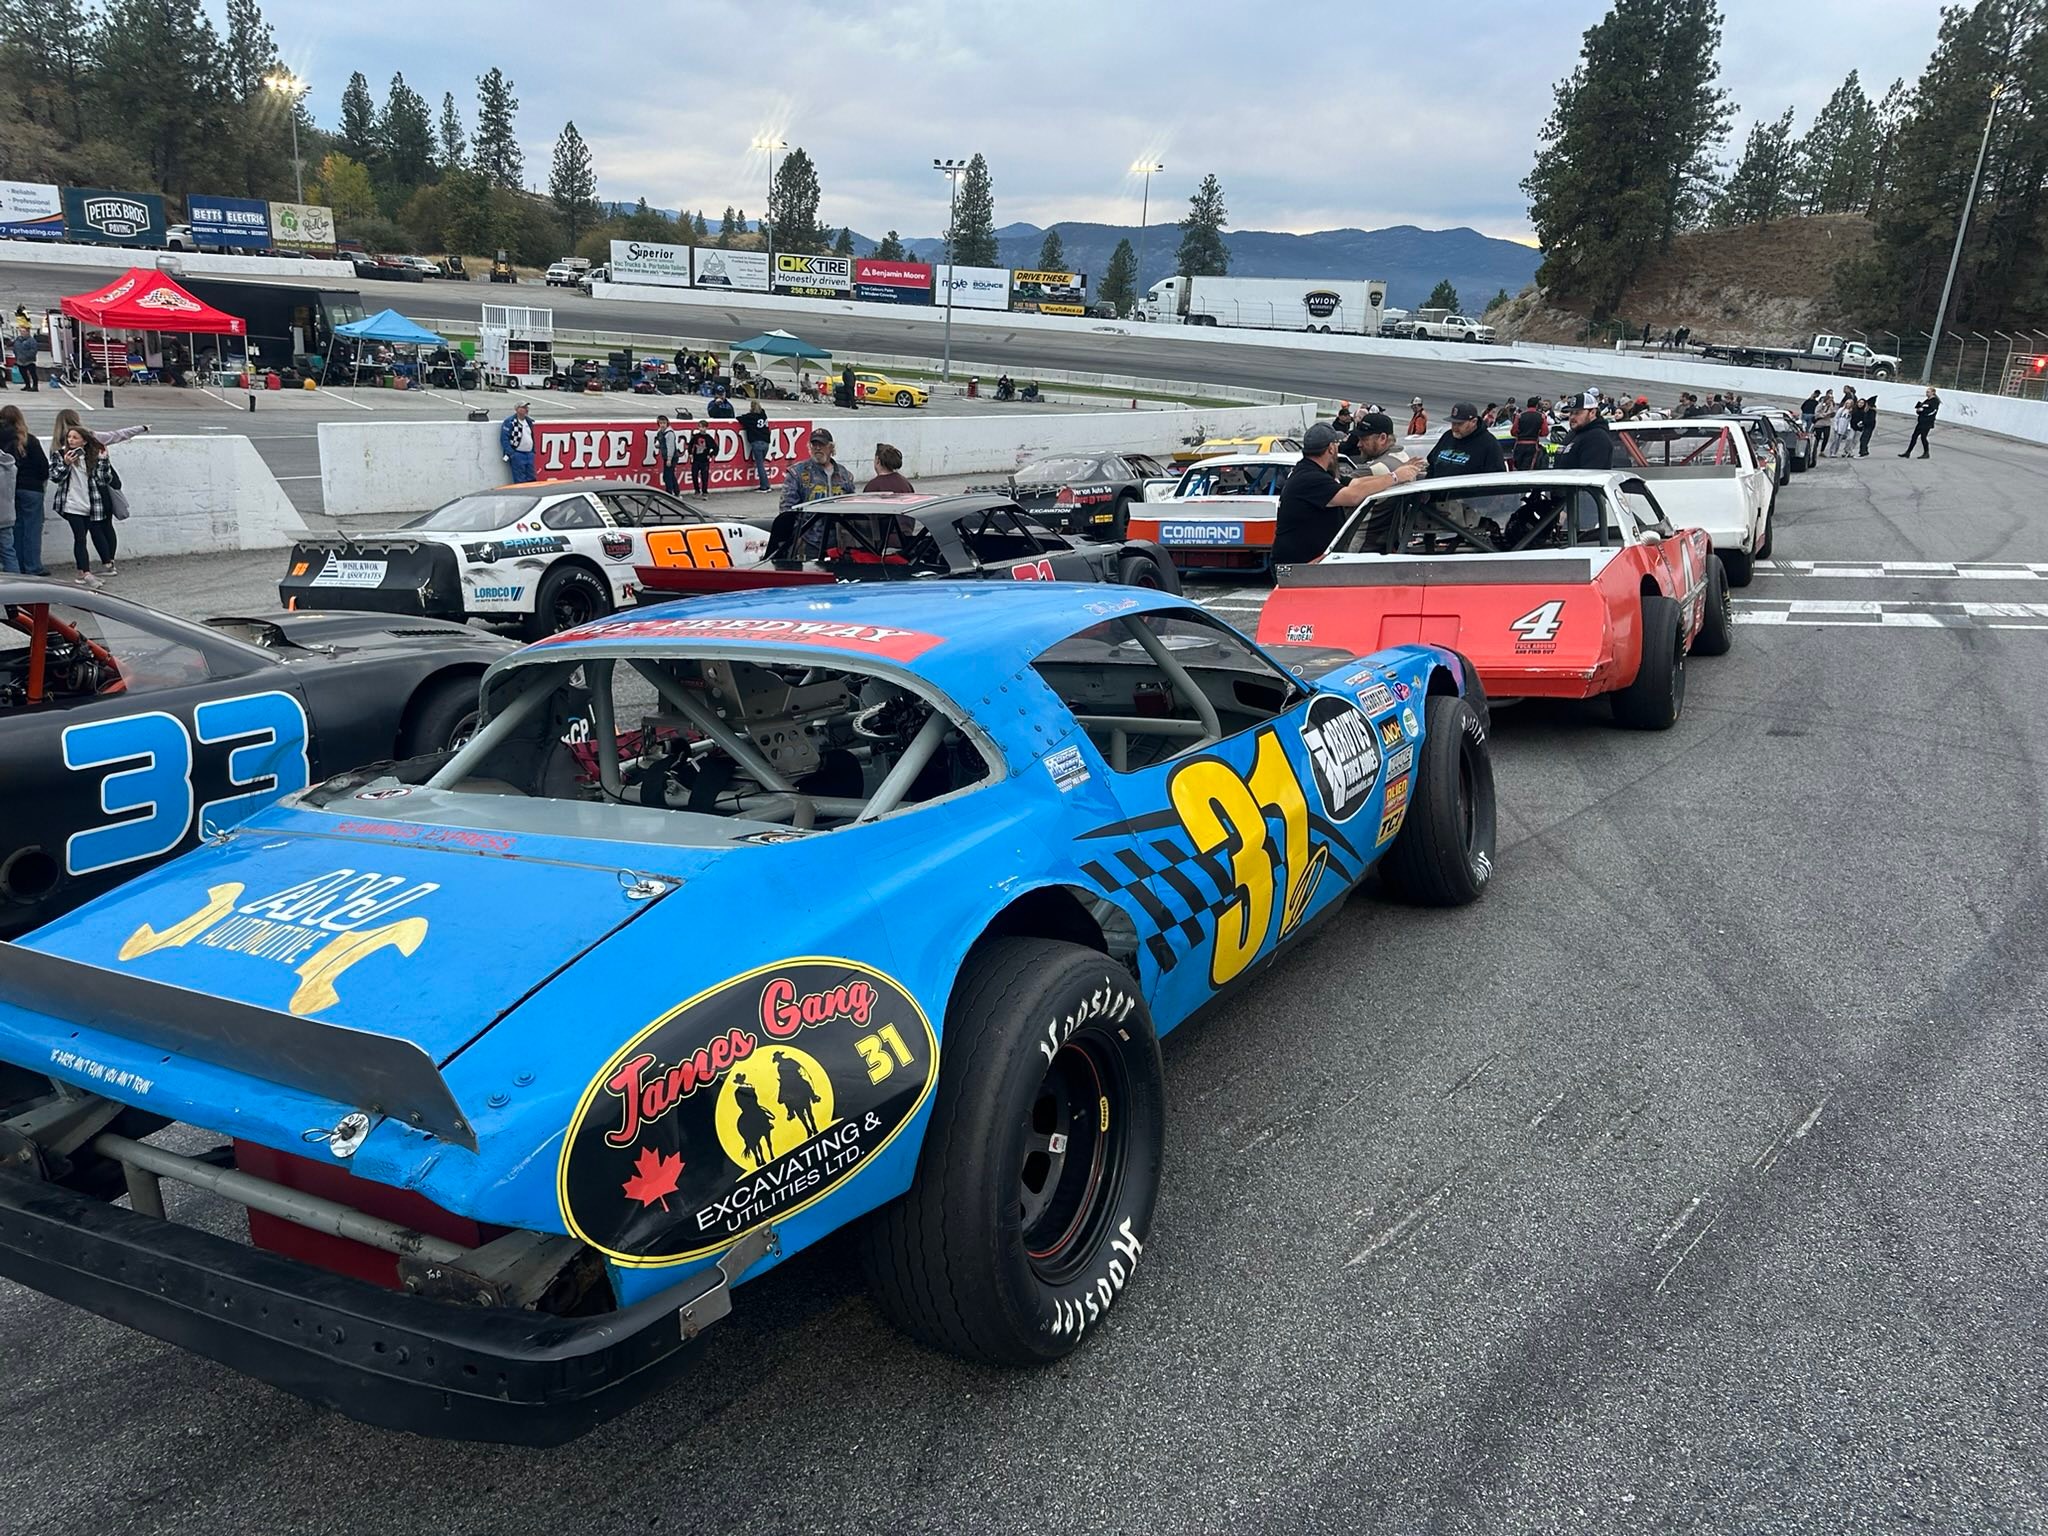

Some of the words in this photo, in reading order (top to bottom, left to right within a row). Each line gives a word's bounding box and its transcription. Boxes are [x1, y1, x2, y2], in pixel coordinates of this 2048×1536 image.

[89, 203, 122, 221] PETERS
[123, 204, 145, 224] BROS
[192, 208, 222, 221] BETTS
[226, 211, 266, 225] ELECTRIC
[108, 224, 131, 233] PAVING
[627, 243, 674, 261] Superior
[779, 256, 811, 272] OK
[817, 261, 846, 273] TIRE
[779, 273, 817, 286] Honestly
[819, 276, 848, 286] driven.
[872, 269, 902, 280] Benjamin
[904, 271, 925, 280] Moore
[1016, 272, 1042, 281] DRIVE
[1042, 274, 1069, 283] THESE.
[790, 287, 836, 296] 250.492.7575
[541, 430, 633, 470] THE
[1162, 526, 1241, 539] COMMAND
[502, 537, 562, 549] PRIMAL
[518, 546, 554, 556] ELECTRIC
[347, 572, 382, 580] ASSOCIATES
[474, 587, 509, 599] LORDCO
[1509, 600, 1566, 641] 4
[652, 618, 915, 642] FEEDWAY
[1287, 633, 1313, 641] TRUDEAU
[1322, 708, 1371, 763] BRUTUS
[61, 690, 310, 876] 33
[424, 828, 517, 851] EXPRESS
[1169, 724, 1310, 989] 31
[196, 915, 329, 964] AUTOMOTIVE
[605, 1029, 756, 1147] James
[760, 978, 878, 1039] Gang
[854, 1023, 914, 1085] 31
[696, 1124, 859, 1231] EXCAVATING
[864, 1111, 882, 1131] &
[727, 1172, 820, 1232] UTILITIES
[826, 1146, 865, 1181] LTD.
